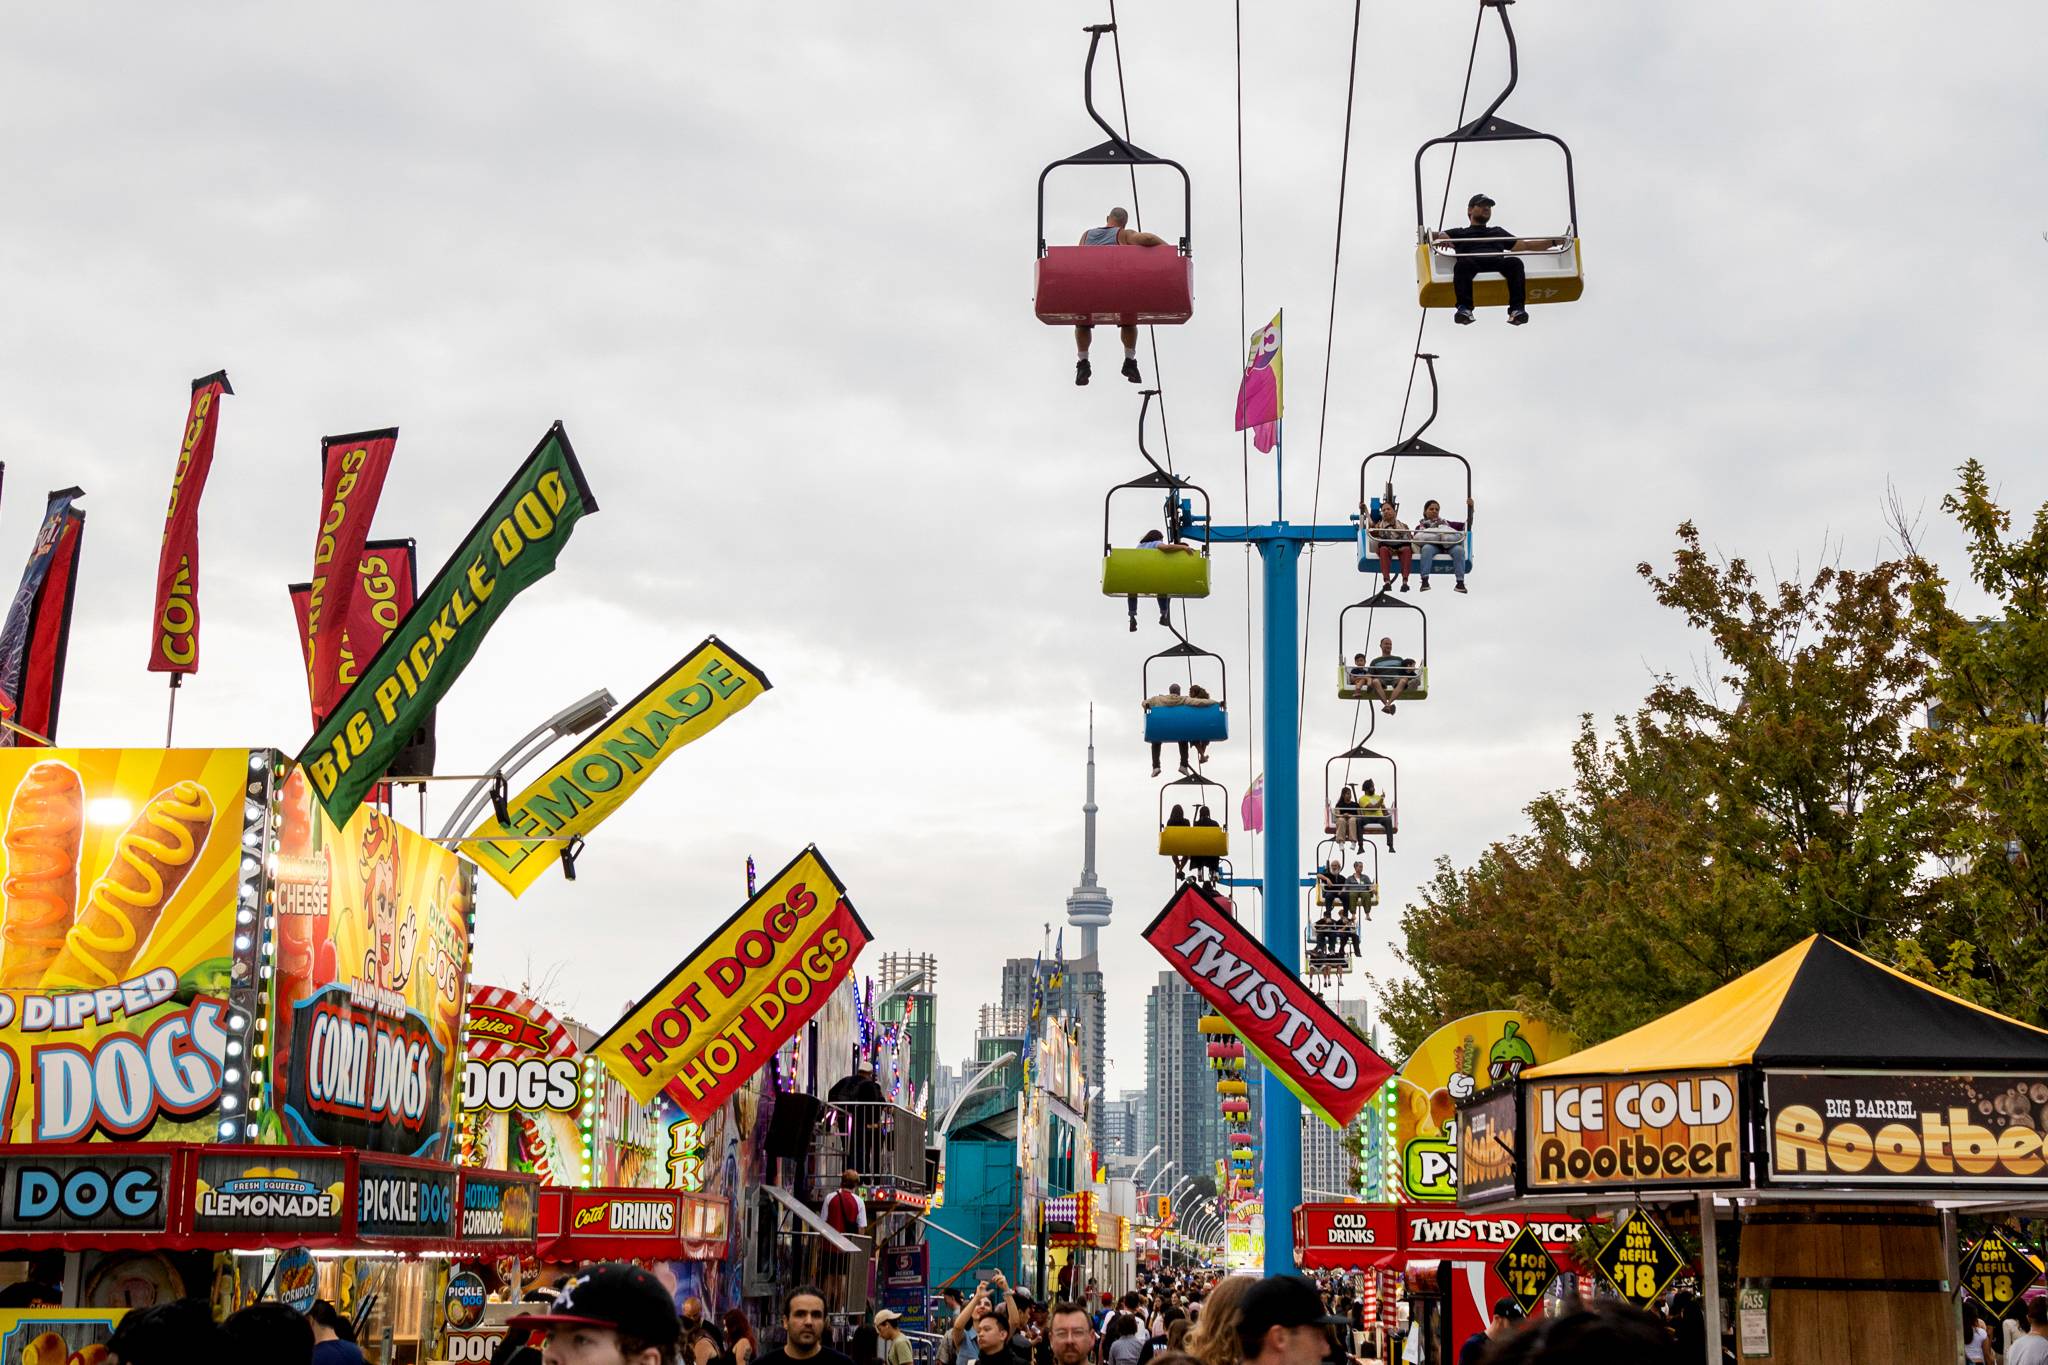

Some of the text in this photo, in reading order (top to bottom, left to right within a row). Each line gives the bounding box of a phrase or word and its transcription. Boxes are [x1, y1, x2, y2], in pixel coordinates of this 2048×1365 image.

[315, 447, 368, 566] DOGS
[1276, 544, 1285, 559] 7
[310, 714, 374, 801] BIG
[373, 553, 496, 726] PICKLE
[476, 658, 747, 874] LEMONADE
[277, 882, 328, 915] CHEESE
[428, 902, 464, 969] PICKLE
[426, 935, 457, 1003] DOG
[620, 882, 818, 1077] HOT DOGS
[21, 966, 179, 1032] DIPPED
[1173, 918, 1358, 1090] TWISTED
[675, 928, 850, 1101] HOT DOGS
[38, 1001, 227, 1141] DOGS
[309, 1012, 429, 1121] CORN DOGS
[464, 1060, 577, 1109] DOGS
[1541, 1078, 1733, 1134] ICE COLD
[1825, 1099, 1917, 1119] BIG BARREL
[1775, 1104, 2048, 1175] Rootbe
[1540, 1134, 1732, 1180] Rootbeer
[19, 1170, 157, 1217] DOG
[234, 1181, 305, 1192] FRESH SQUEEZED
[465, 1184, 499, 1208] HOTDOG
[204, 1194, 331, 1217] LEMONADE
[363, 1179, 418, 1222] PICKLE
[420, 1184, 450, 1224] DOG
[463, 1210, 503, 1235] CORNDOG
[575, 1203, 608, 1228] Cold
[611, 1203, 673, 1230] DRINKS
[1334, 1214, 1366, 1228] COLD
[1628, 1221, 1648, 1234] ALL
[1328, 1229, 1375, 1243] DRINKS
[1410, 1218, 1520, 1243] TWISTED
[1626, 1234, 1652, 1248] DAY
[1619, 1248, 1658, 1263] REFILL
[1981, 1251, 2006, 1262] DAY
[1983, 1239, 2004, 1251] ALL
[1508, 1253, 1546, 1268] 2 FOR
[1975, 1262, 2014, 1273] REFILL
[281, 1283, 315, 1303] CORNDOG
[448, 1286, 482, 1296] PICKLE
[1614, 1262, 1656, 1298] $18
[1971, 1274, 2014, 1302] $18
[462, 1296, 482, 1305] DOG
[1743, 1294, 1763, 1309] PASS
